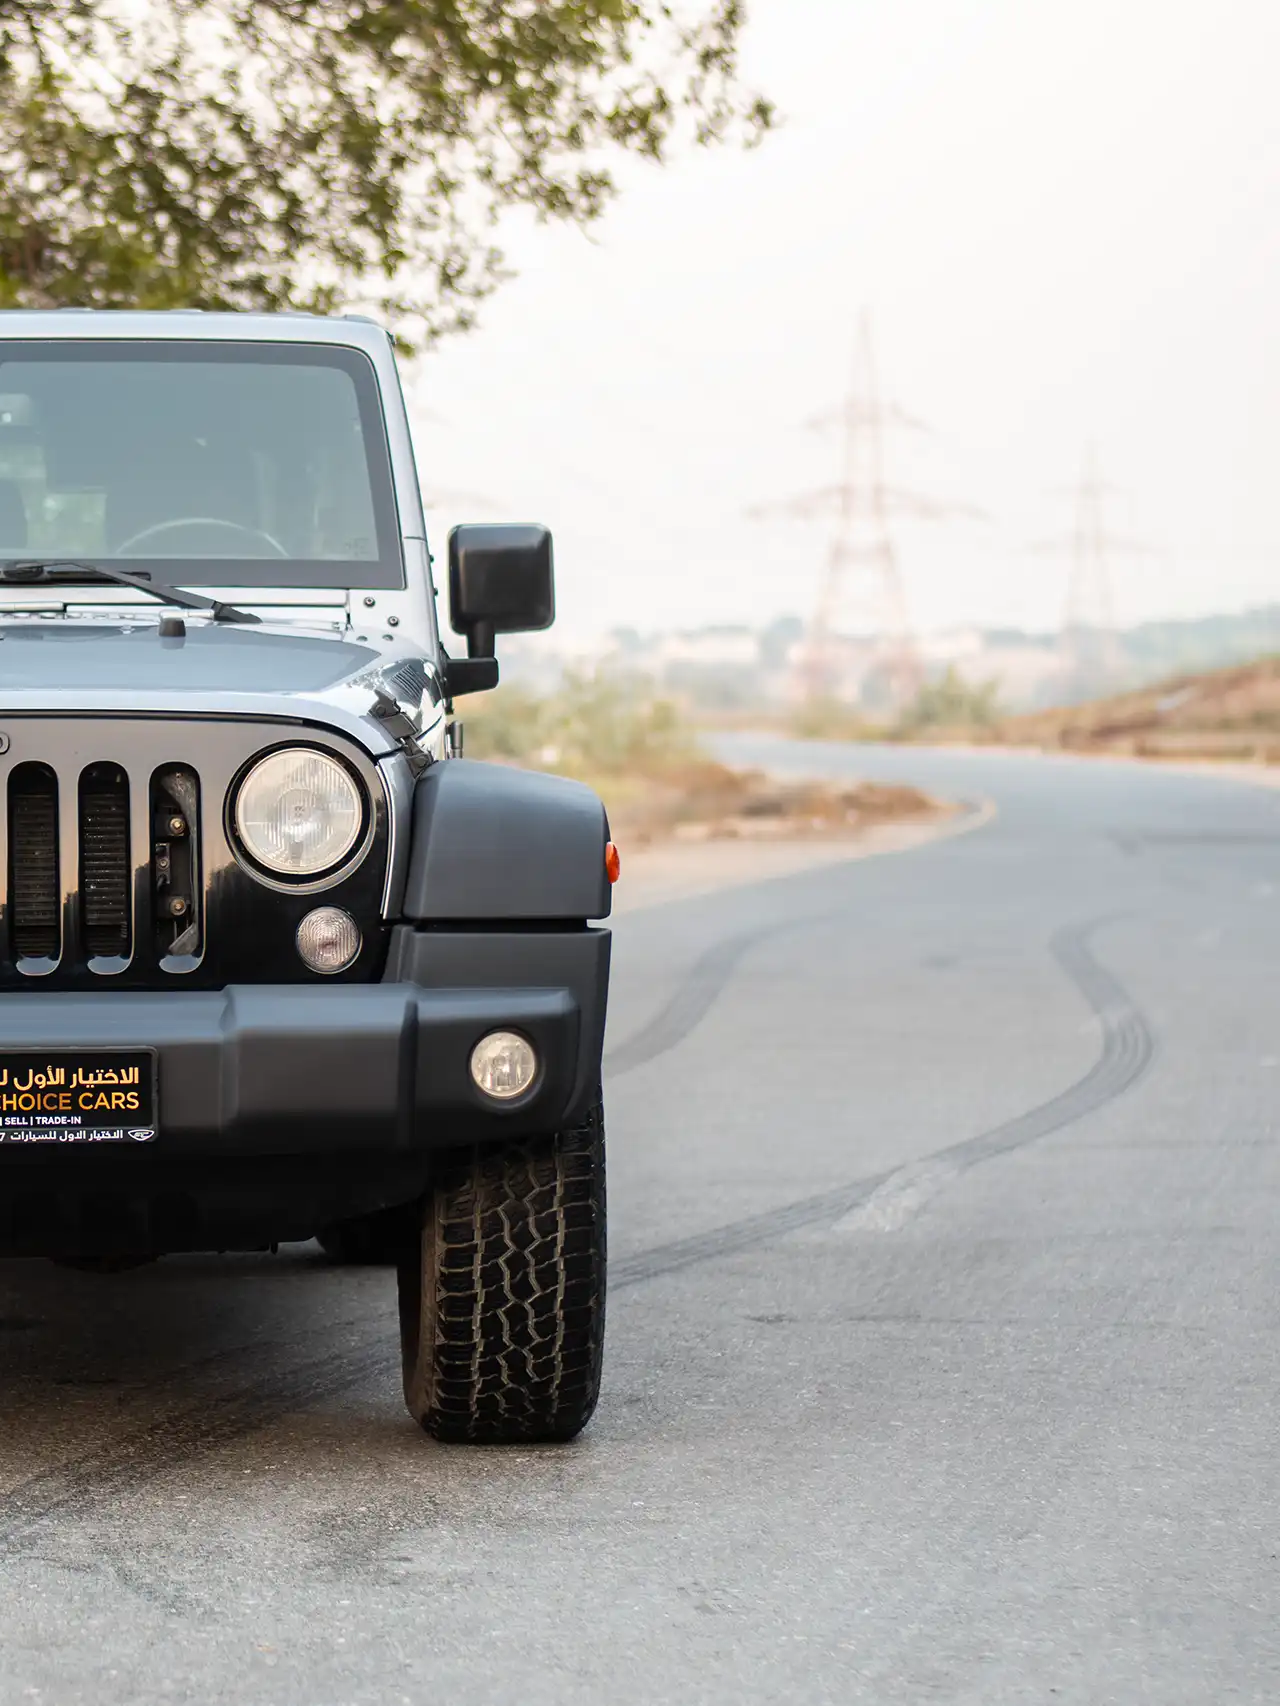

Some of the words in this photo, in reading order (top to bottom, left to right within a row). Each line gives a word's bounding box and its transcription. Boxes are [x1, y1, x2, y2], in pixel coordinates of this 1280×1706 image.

[14, 1065, 65, 1091] الأول
[69, 1067, 139, 1088] الاختيار
[78, 1091, 139, 1110] CARS
[4, 1117, 29, 1126] SELL
[35, 1116, 82, 1126] TRADE-IN
[10, 1130, 57, 1142] للسيارات
